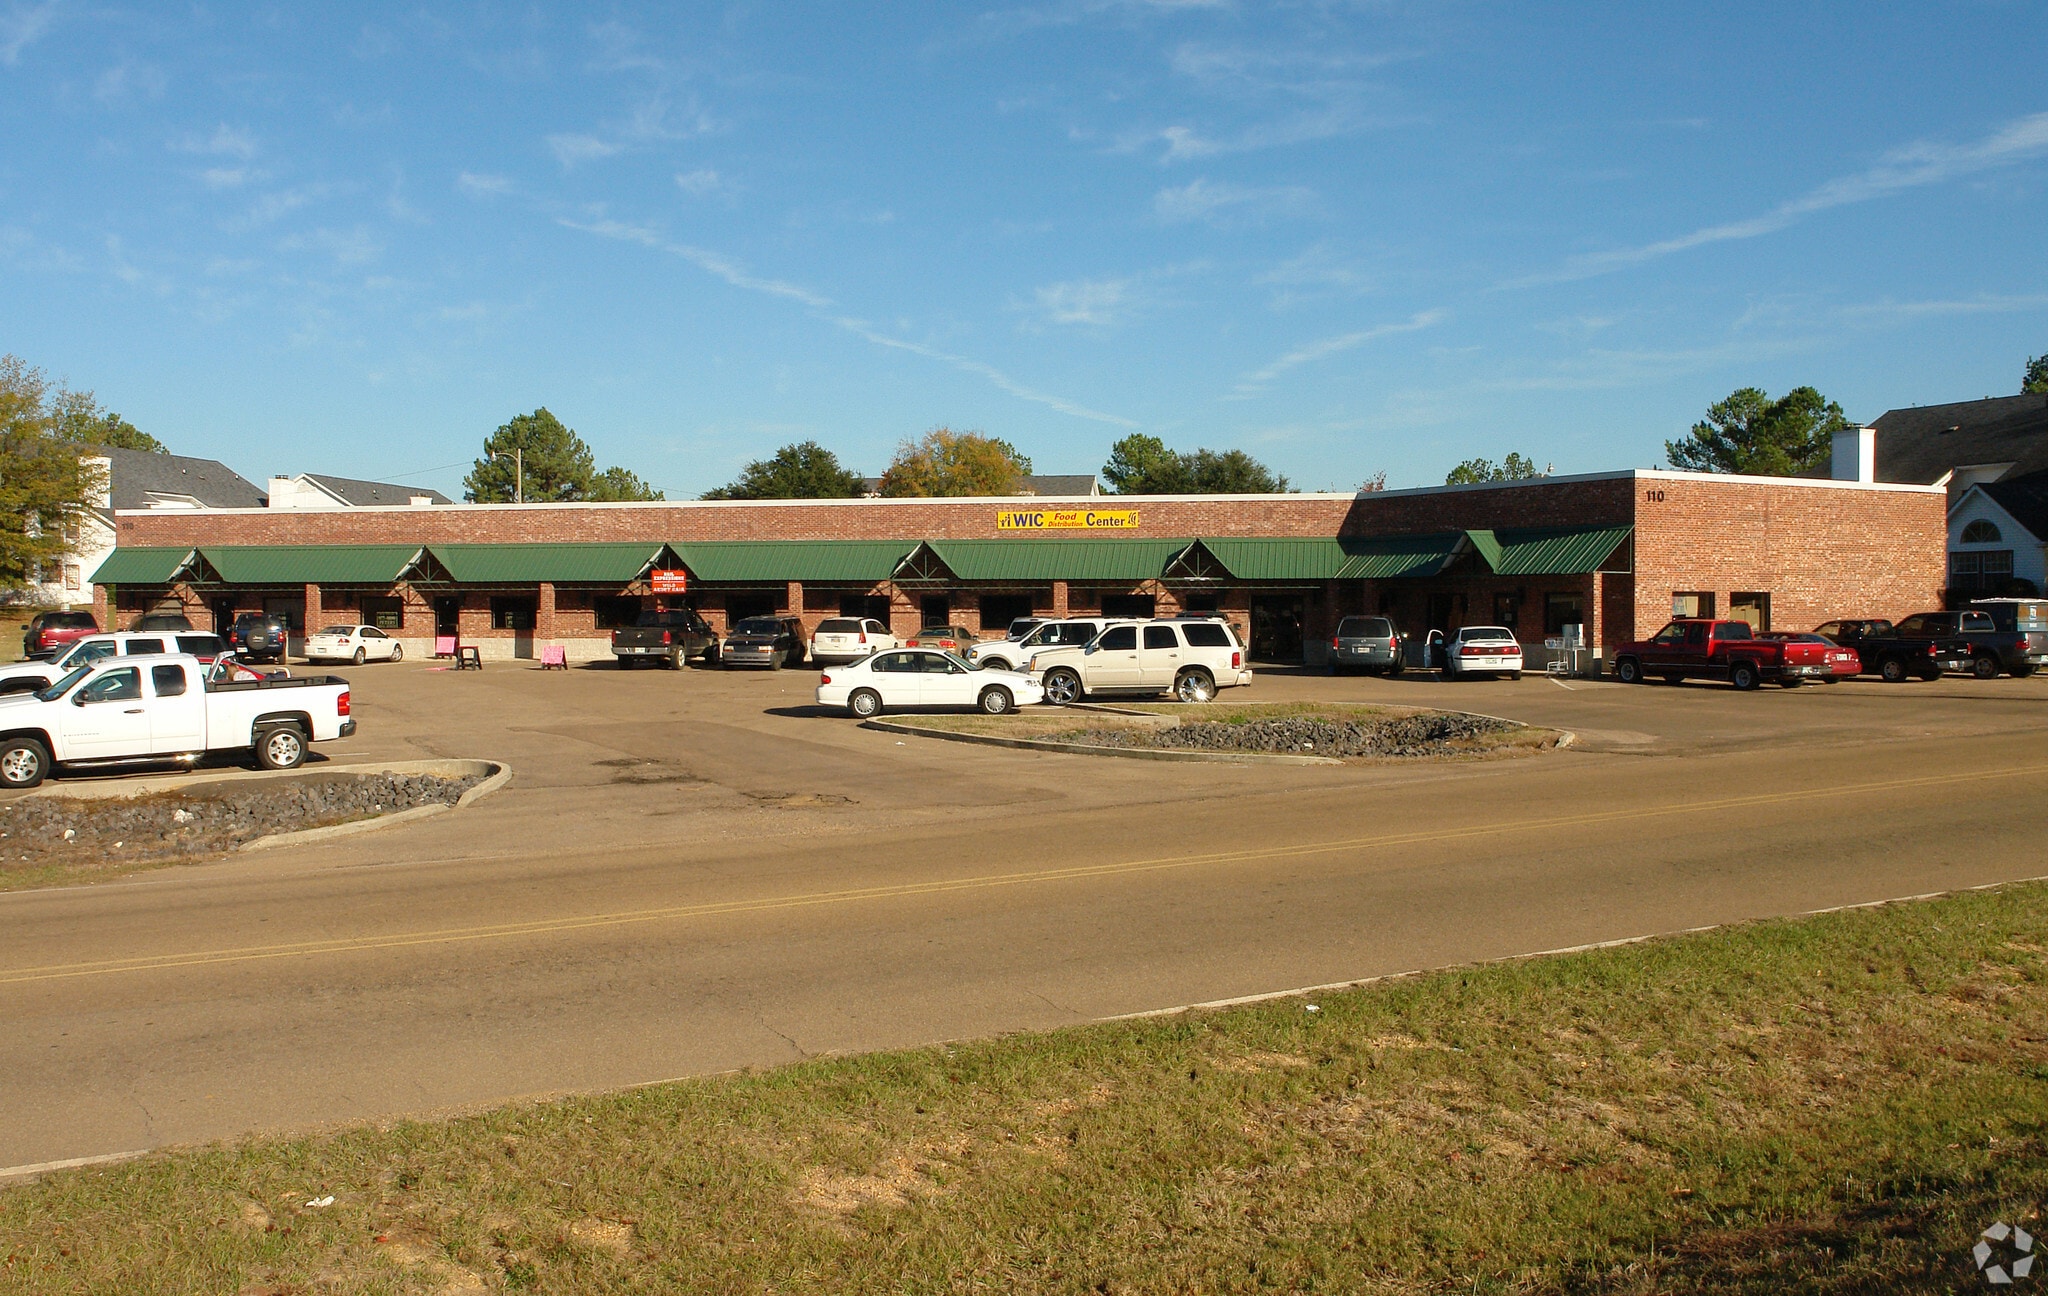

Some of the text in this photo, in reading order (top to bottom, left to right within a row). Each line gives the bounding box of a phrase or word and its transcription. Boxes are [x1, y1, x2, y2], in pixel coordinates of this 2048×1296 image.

[1646, 490, 1664, 502] 110
[1013, 513, 1044, 527] WIC
[1054, 512, 1077, 521] Food
[1086, 512, 1125, 527] Center
